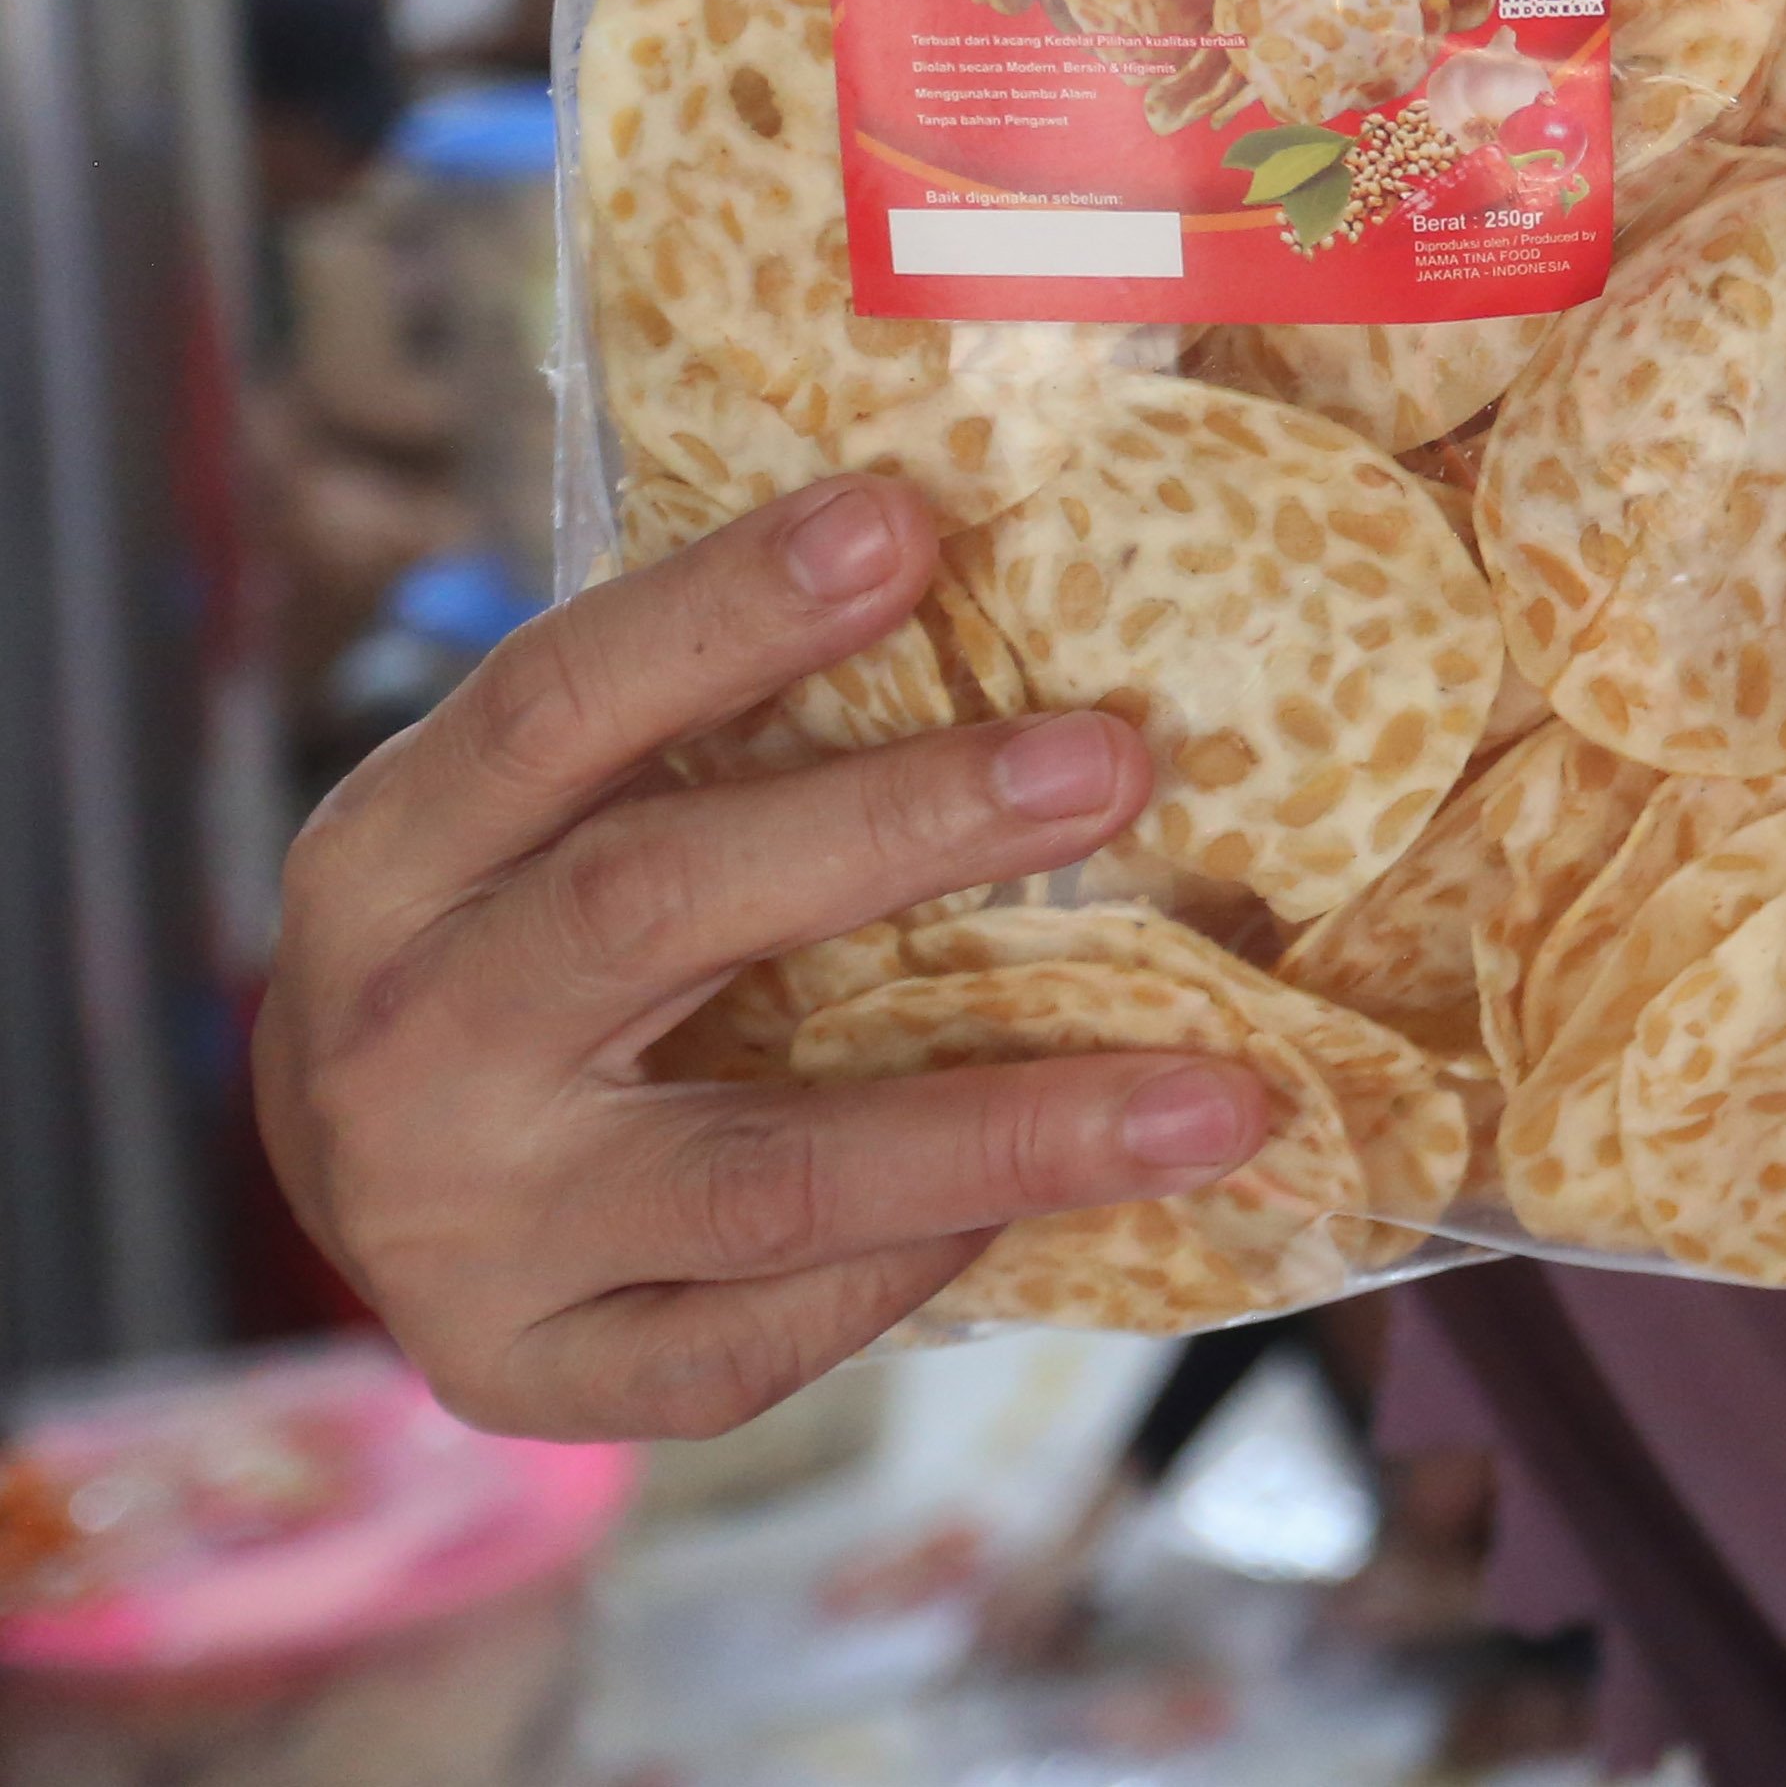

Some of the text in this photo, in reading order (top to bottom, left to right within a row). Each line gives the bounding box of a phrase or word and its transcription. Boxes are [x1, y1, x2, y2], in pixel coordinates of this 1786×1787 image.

[1501, 3, 1603, 16] INDONESIA
[912, 35, 1246, 49] Terbuat dari kacang Kedelai Pilihan kualitas terbaik
[912, 61, 955, 73] Diolah
[959, 62, 1002, 73] secara
[1063, 62, 1106, 73] Bersih
[1109, 62, 1119, 74] &
[1123, 63, 1176, 75] Higienis
[915, 89, 1096, 102] Menggunakan bumbu Alami
[917, 114, 1069, 128] Tanpa bahan Pengawet
[926, 191, 1123, 206] Baik digunakan sebelum:
[1413, 214, 1466, 232] Berat
[1484, 209, 1544, 229] 250gr
[1415, 238, 1481, 255] Diproduksi
[1484, 237, 1510, 249] oleh
[1521, 230, 1579, 245] Produced
[1582, 230, 1597, 242] by
[1416, 248, 1541, 267] MAMA TINA FOOD
[1417, 267, 1481, 282] JAKARTA
[1493, 261, 1571, 277] INDONESIA
